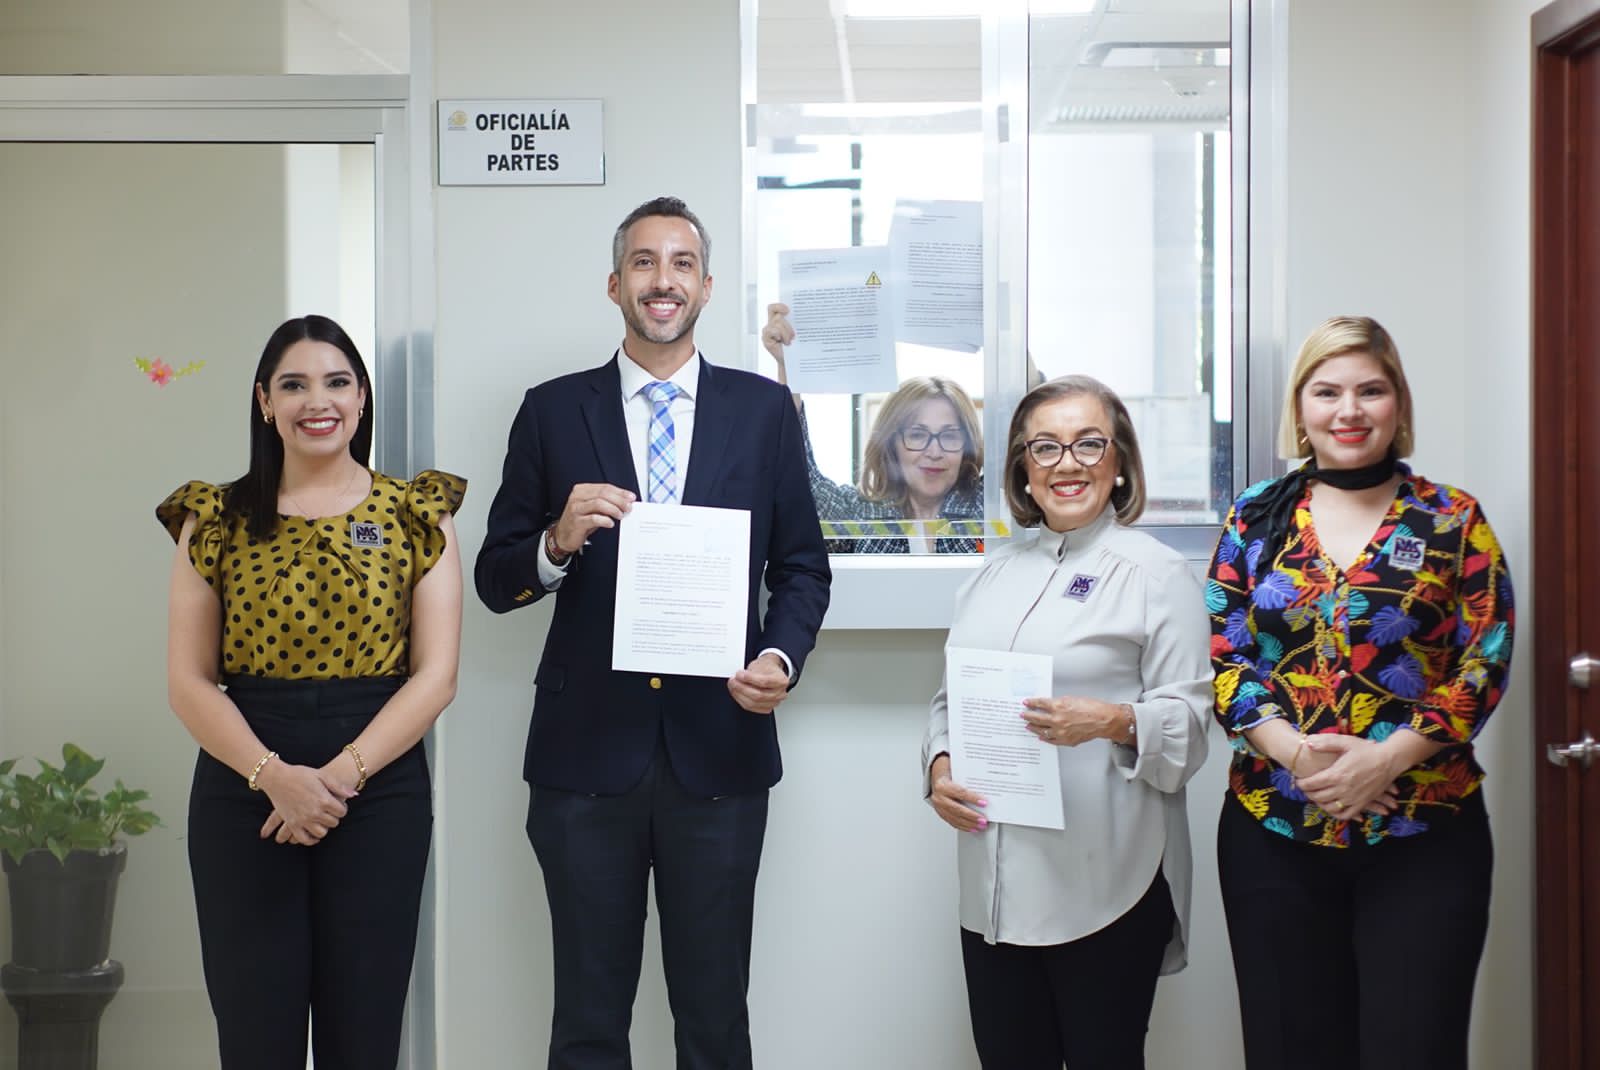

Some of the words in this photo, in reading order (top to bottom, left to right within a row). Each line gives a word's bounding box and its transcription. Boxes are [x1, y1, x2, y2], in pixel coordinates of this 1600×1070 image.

[475, 109, 570, 131] OFICIALÍA
[511, 134, 535, 150] DE
[487, 154, 559, 171] PARTES
